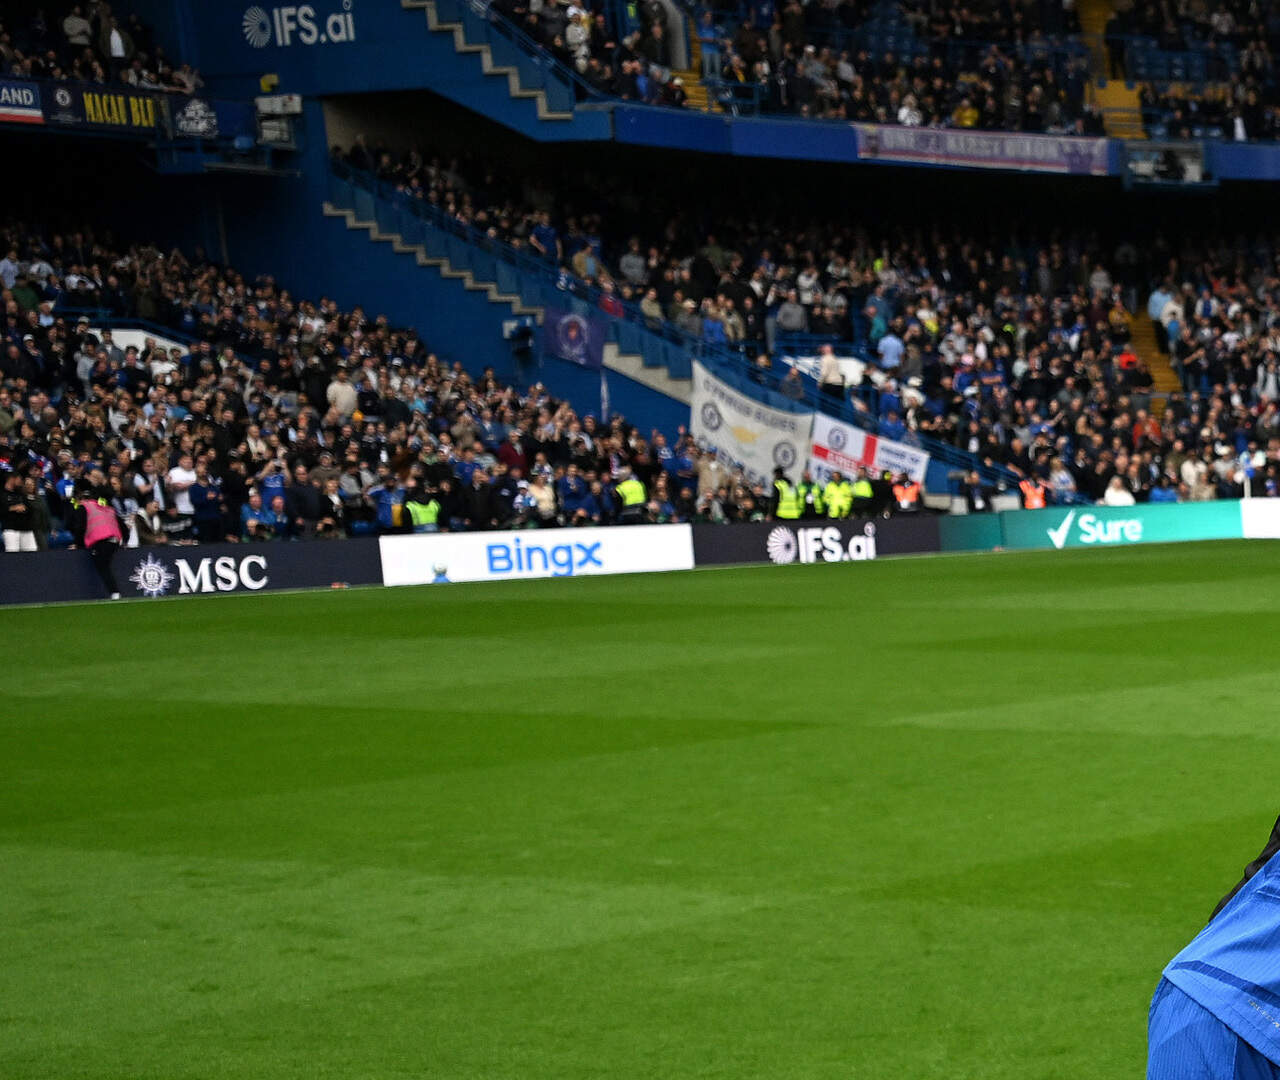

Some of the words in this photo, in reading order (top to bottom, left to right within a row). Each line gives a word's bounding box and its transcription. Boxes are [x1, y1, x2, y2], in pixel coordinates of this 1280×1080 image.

[272, 1, 356, 46] IFS.ai
[797, 521, 877, 563] IFS.ai
[1078, 514, 1143, 543] Sure
[174, 555, 268, 594] MSC
